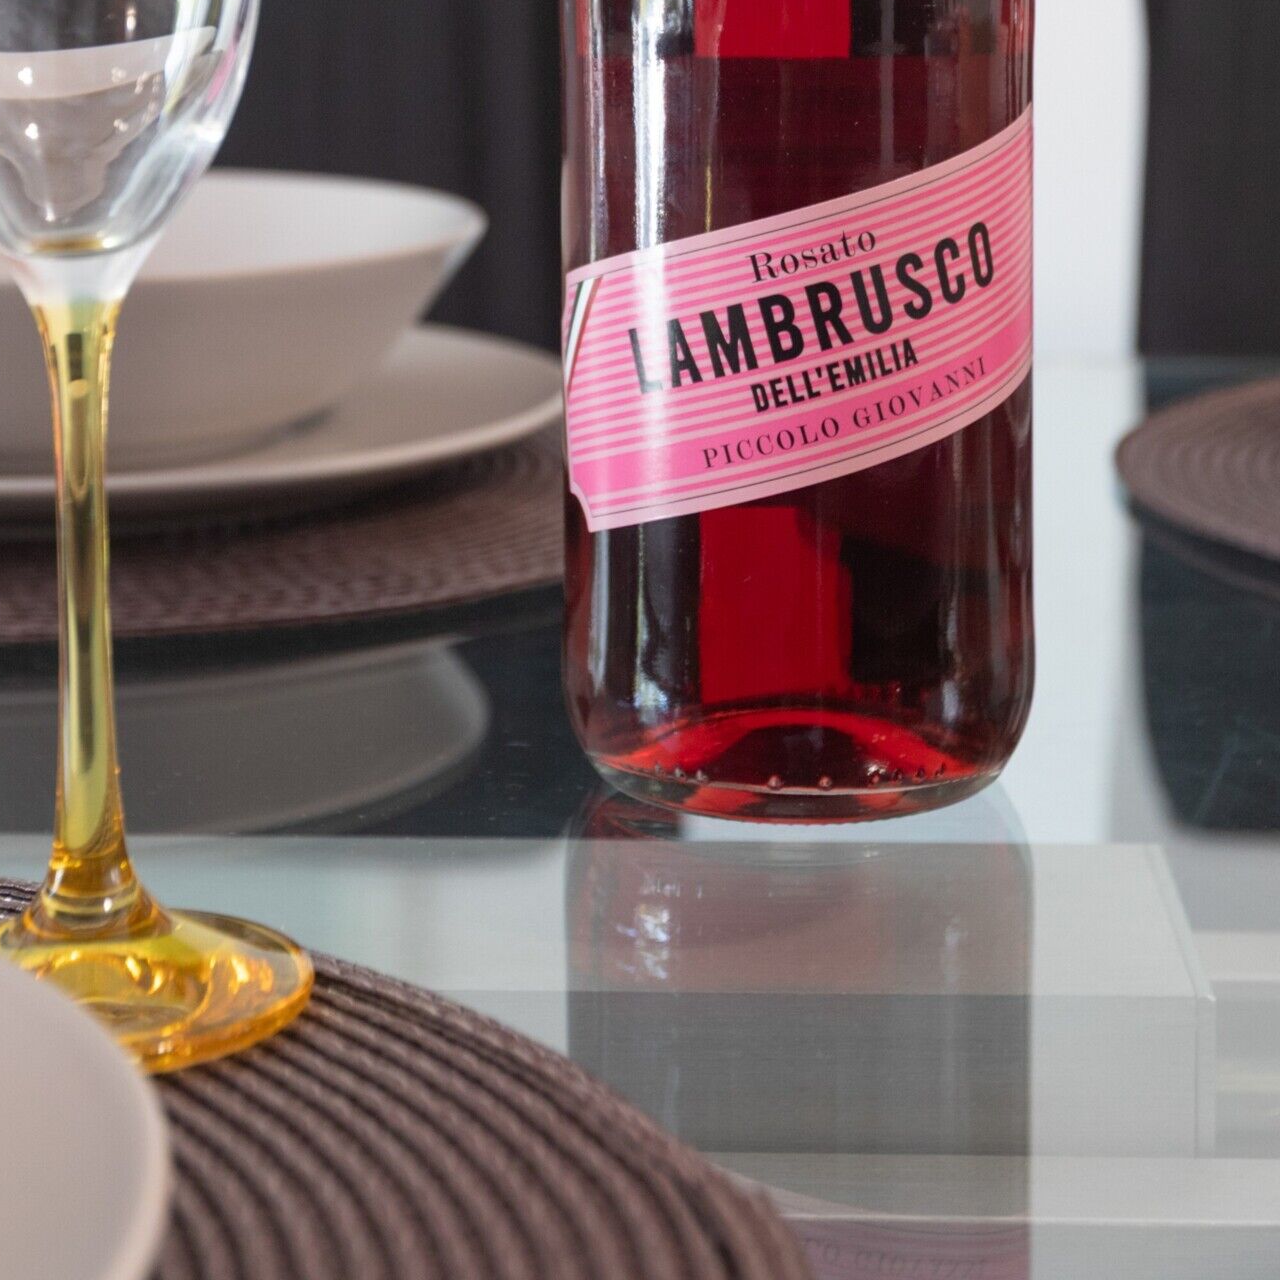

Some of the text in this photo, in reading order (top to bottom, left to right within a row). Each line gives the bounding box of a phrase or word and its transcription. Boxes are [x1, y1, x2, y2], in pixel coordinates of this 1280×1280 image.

[748, 229, 876, 283] Rosato
[628, 222, 994, 394] LAMBRUSCO
[703, 357, 986, 468] PICCOLO GIOVANNI
[751, 338, 919, 412] DELL'EMILIA
